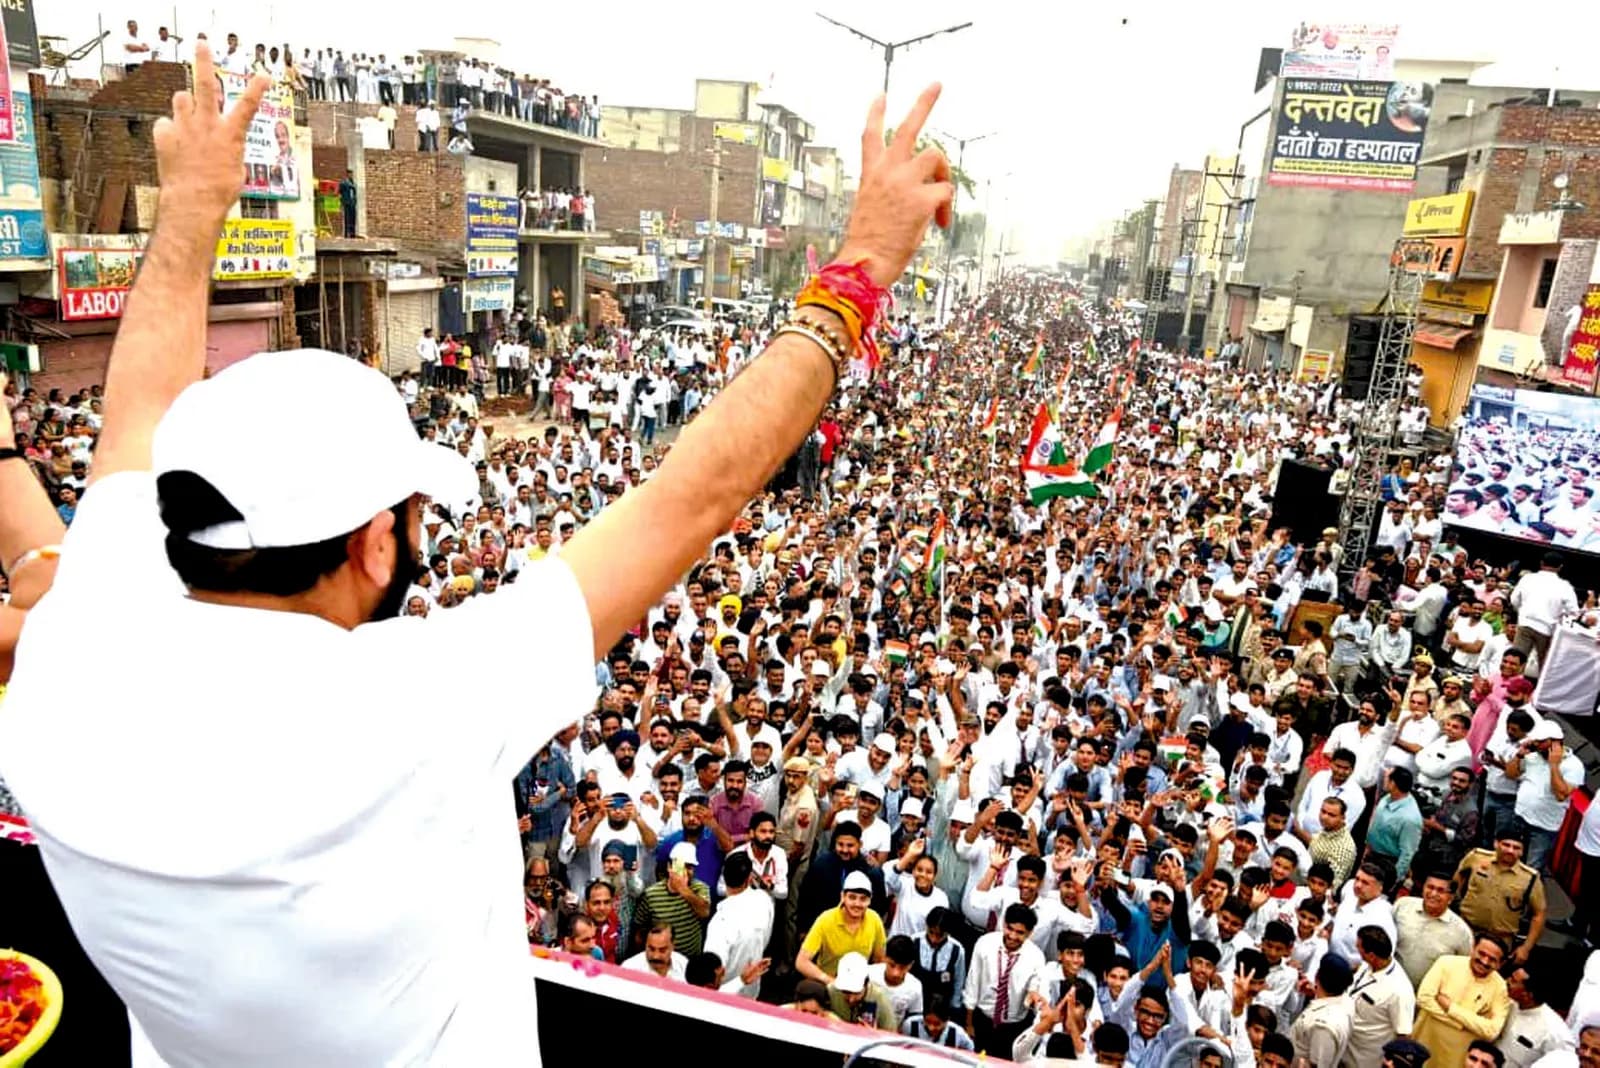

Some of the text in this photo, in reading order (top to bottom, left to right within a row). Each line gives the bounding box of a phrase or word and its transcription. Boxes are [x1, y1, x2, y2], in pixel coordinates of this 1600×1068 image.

[1284, 82, 1385, 128] दन्तवेदा
[1277, 125, 1421, 163] दाँतों का हस्पताल
[0, 241, 21, 255] ST
